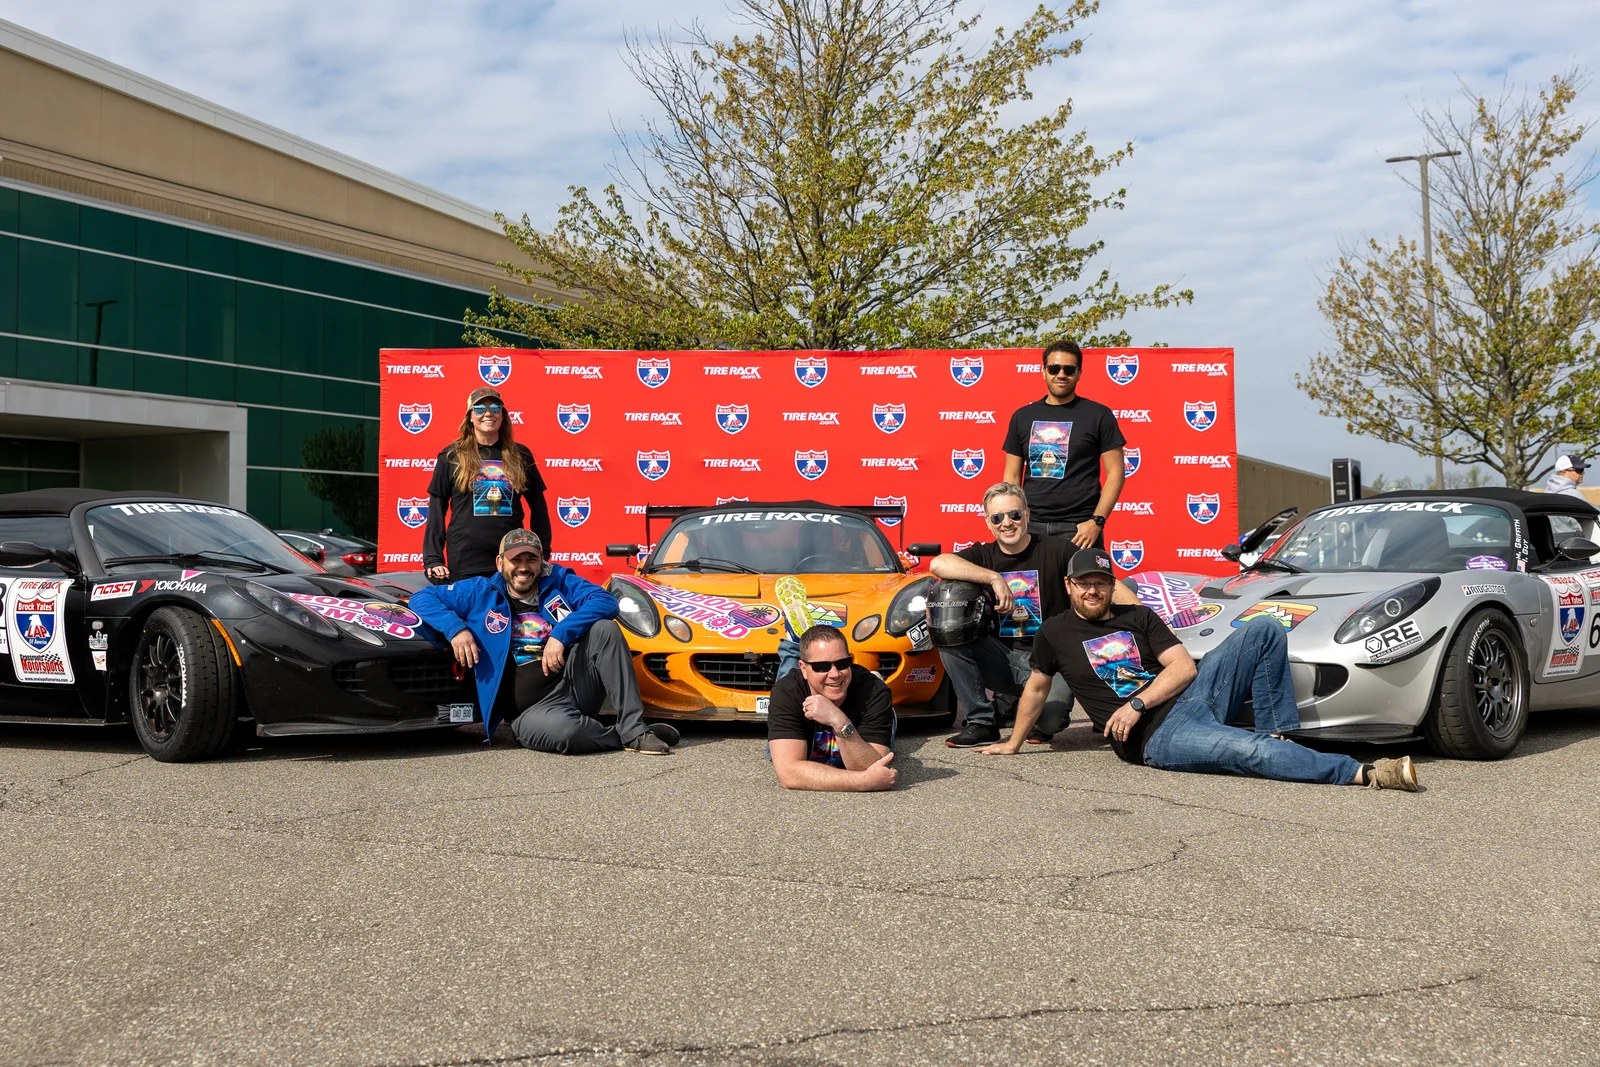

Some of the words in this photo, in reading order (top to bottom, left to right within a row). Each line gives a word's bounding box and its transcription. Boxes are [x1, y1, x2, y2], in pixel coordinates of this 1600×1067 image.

[386, 365, 412, 373] TIRE
[412, 365, 444, 378] RACK
[544, 366, 570, 374] TIRE
[571, 366, 603, 379] RACK
[703, 366, 728, 375] TIRE
[730, 366, 762, 379] RACK
[860, 366, 885, 374] TIRE
[886, 366, 918, 379] RACK
[1016, 364, 1041, 372] TIRE
[1171, 363, 1197, 372] TIRE
[1199, 363, 1228, 376] RACK
[624, 412, 650, 421] TIRE
[650, 412, 682, 425] RACK
[782, 412, 808, 421] TIRE
[808, 412, 840, 425] RACK
[938, 411, 963, 419] TIRE
[964, 411, 996, 424] RACK
[1120, 410, 1152, 422] RACK
[385, 459, 410, 467] TIRE
[544, 458, 570, 467] TIRE
[571, 458, 603, 471] RACK
[703, 459, 728, 467] TIRE
[730, 459, 762, 471] RACK
[861, 458, 886, 466] TIRE
[887, 458, 919, 471] RACK
[1173, 456, 1198, 464] TIRE
[1199, 456, 1231, 468] RACK
[110, 503, 182, 516] TIRE
[178, 503, 249, 519] RACK
[940, 504, 965, 512] TIRE
[1122, 502, 1154, 515] RACK
[1315, 503, 1380, 521] TIRE
[1377, 502, 1472, 514] RACK
[699, 512, 763, 525] TIRE
[765, 512, 842, 524] RACK
[383, 554, 408, 562] TIRE
[571, 552, 603, 565] RACK
[1176, 549, 1201, 557] TIRE
[38, 582, 64, 593] RACK
[93, 582, 134, 595] nasa
[154, 581, 207, 593] YOKOHAMA
[27, 625, 47, 638] LAP
[1564, 619, 1578, 632] LAP
[21, 659, 65, 674] Motorsports
